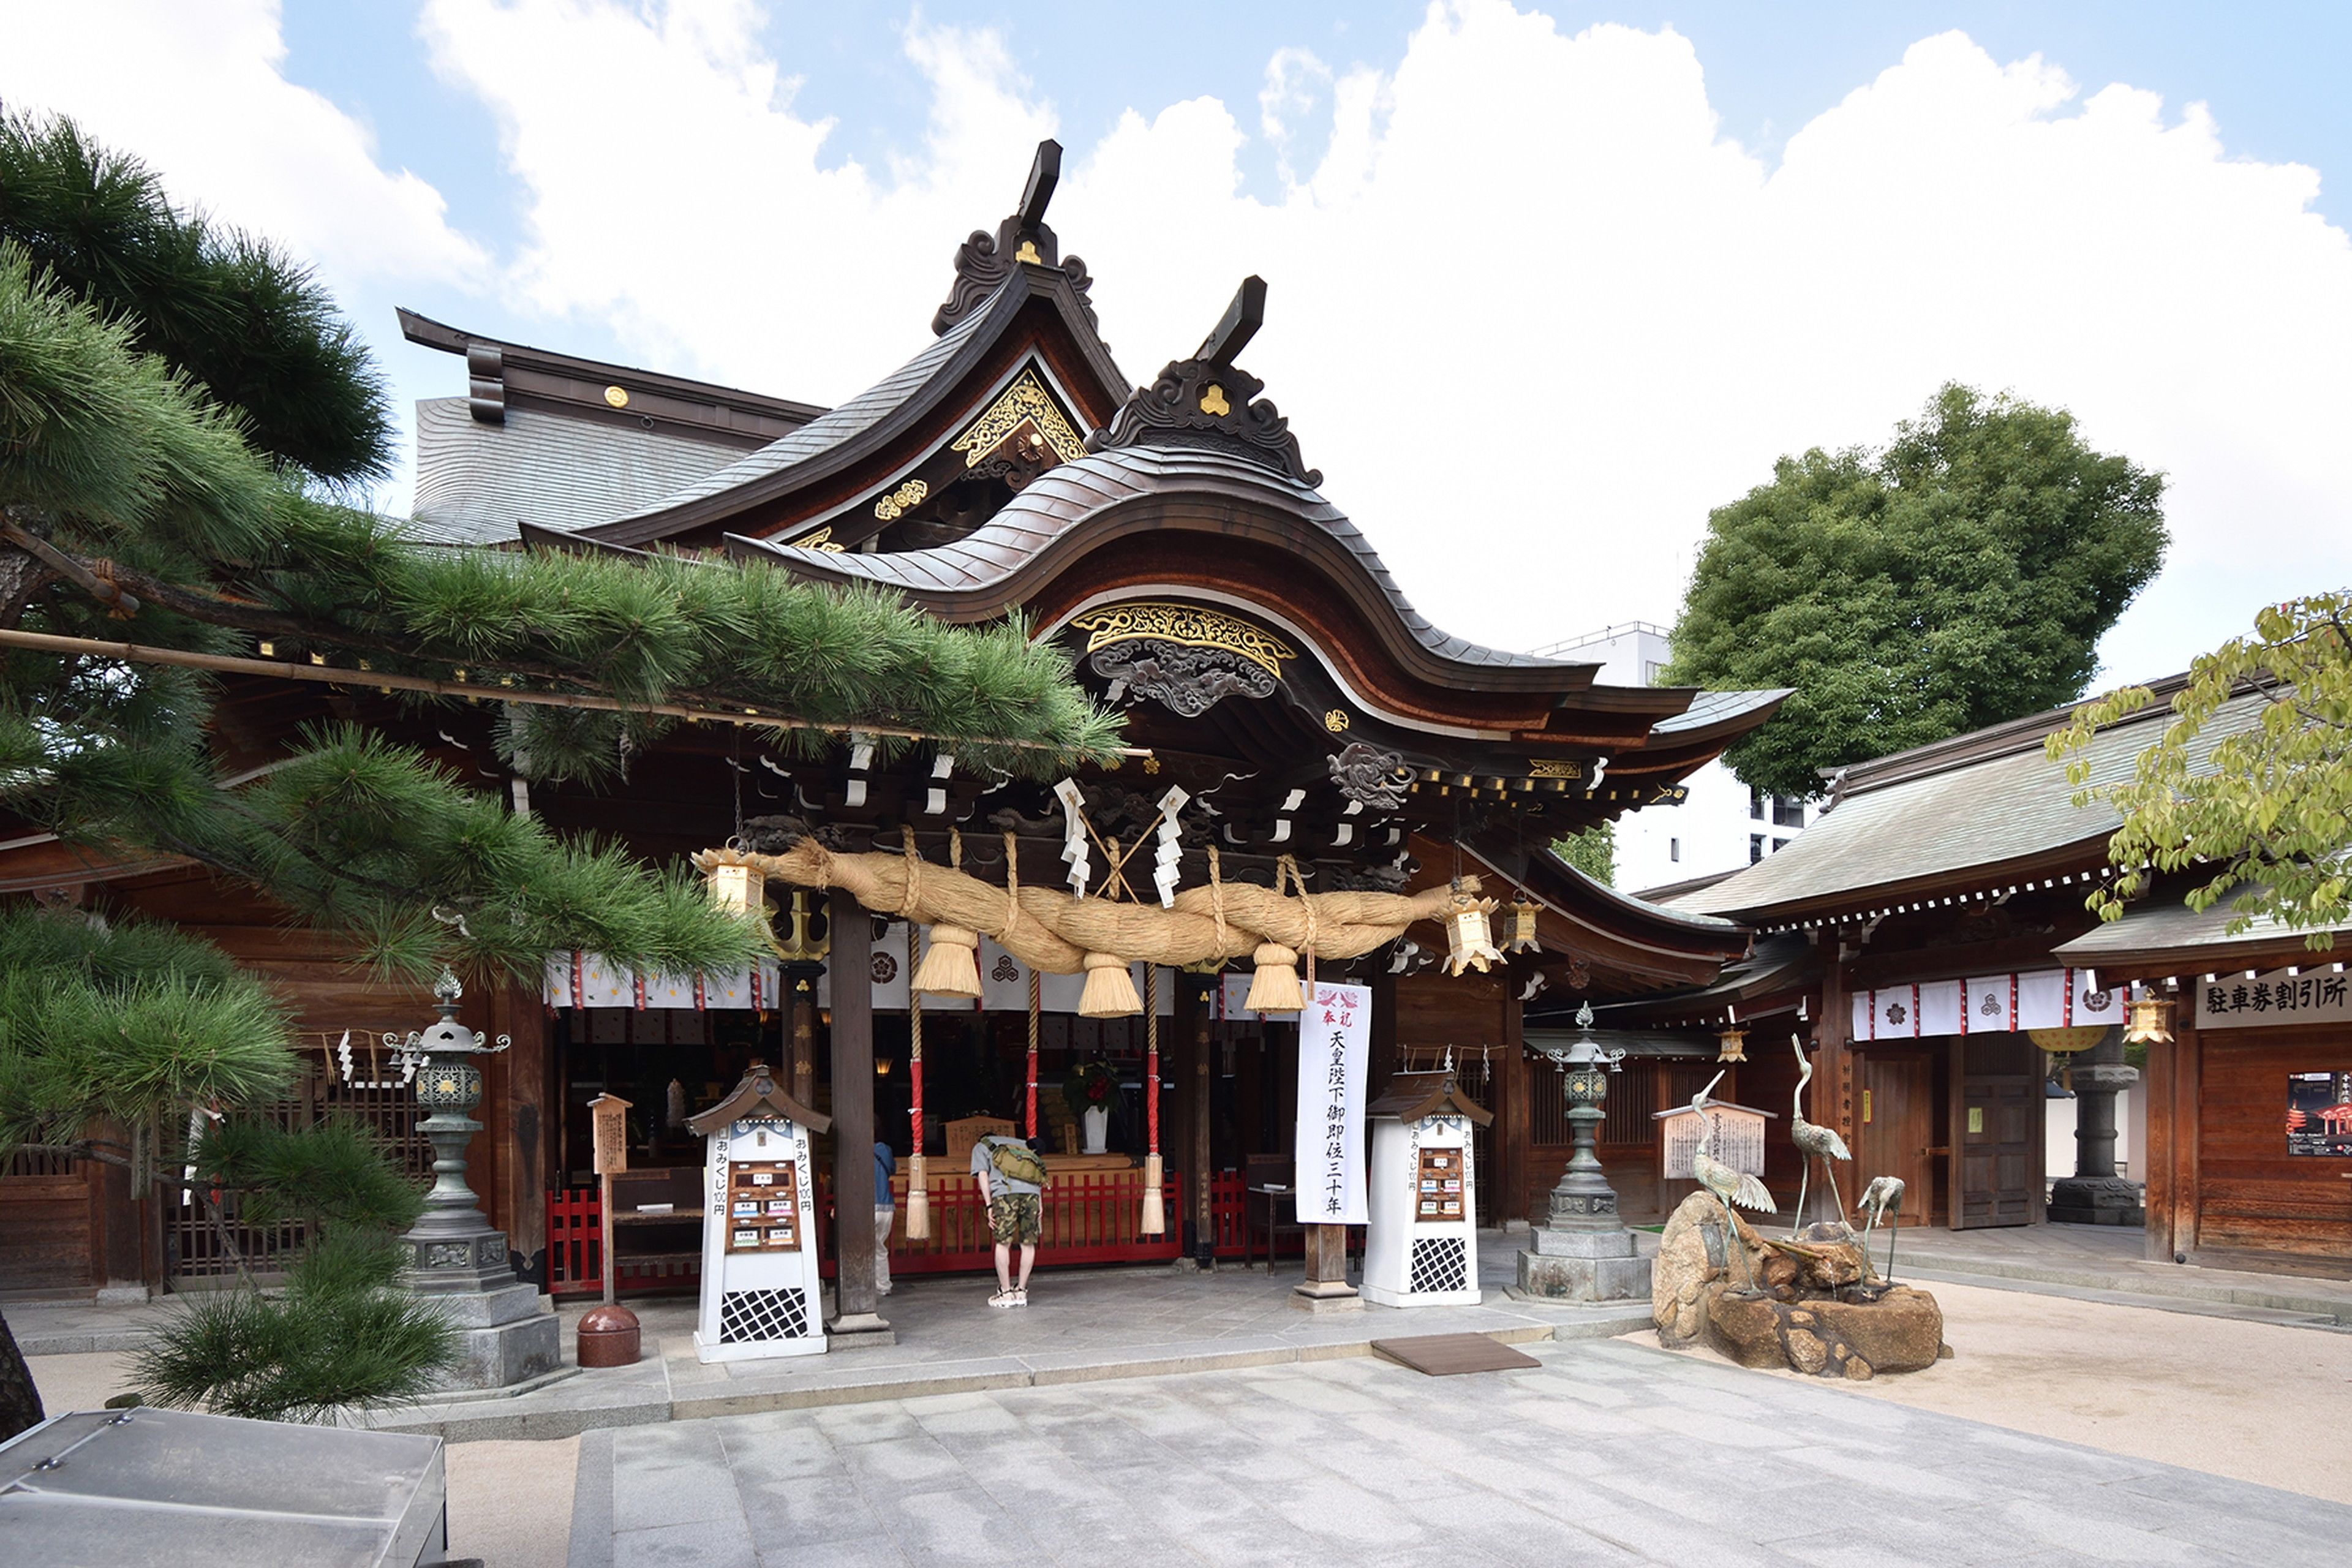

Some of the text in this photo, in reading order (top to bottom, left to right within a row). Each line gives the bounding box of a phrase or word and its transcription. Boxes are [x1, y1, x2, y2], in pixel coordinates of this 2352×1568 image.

[2206, 976, 2348, 1014] 駐車券割引所
[1325, 1031, 1346, 1216] 天皇陛下御即位三十年
